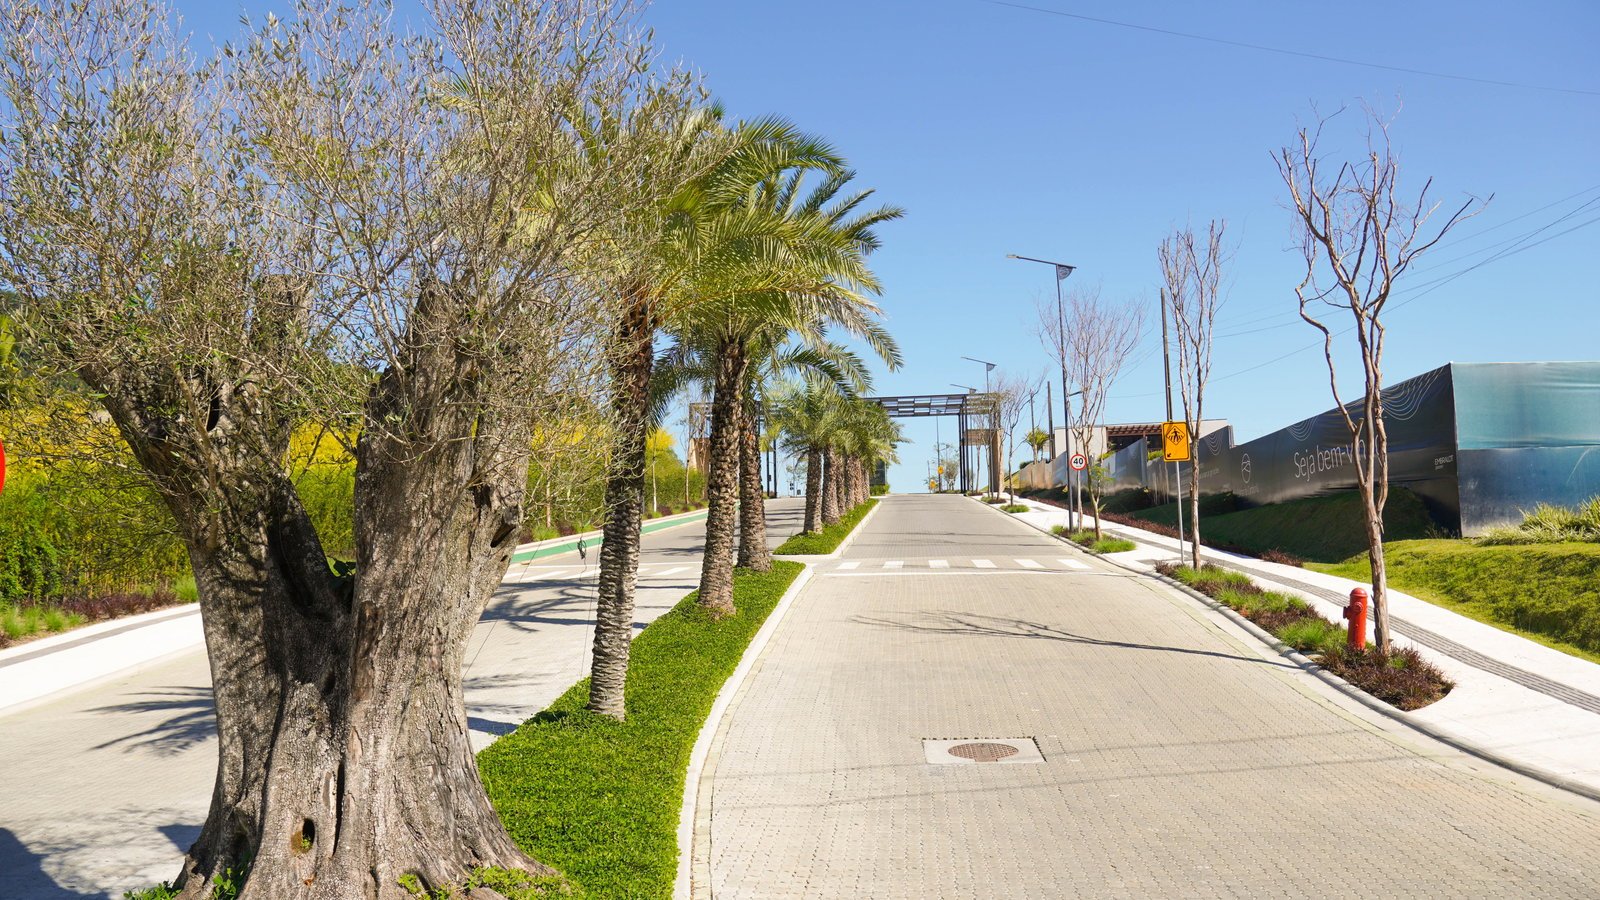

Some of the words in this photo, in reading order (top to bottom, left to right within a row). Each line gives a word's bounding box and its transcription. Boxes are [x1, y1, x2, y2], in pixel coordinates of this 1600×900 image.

[1073, 457, 1084, 465] 40
[1293, 449, 1316, 482] Seja
[1316, 434, 1380, 472] bem-vn
